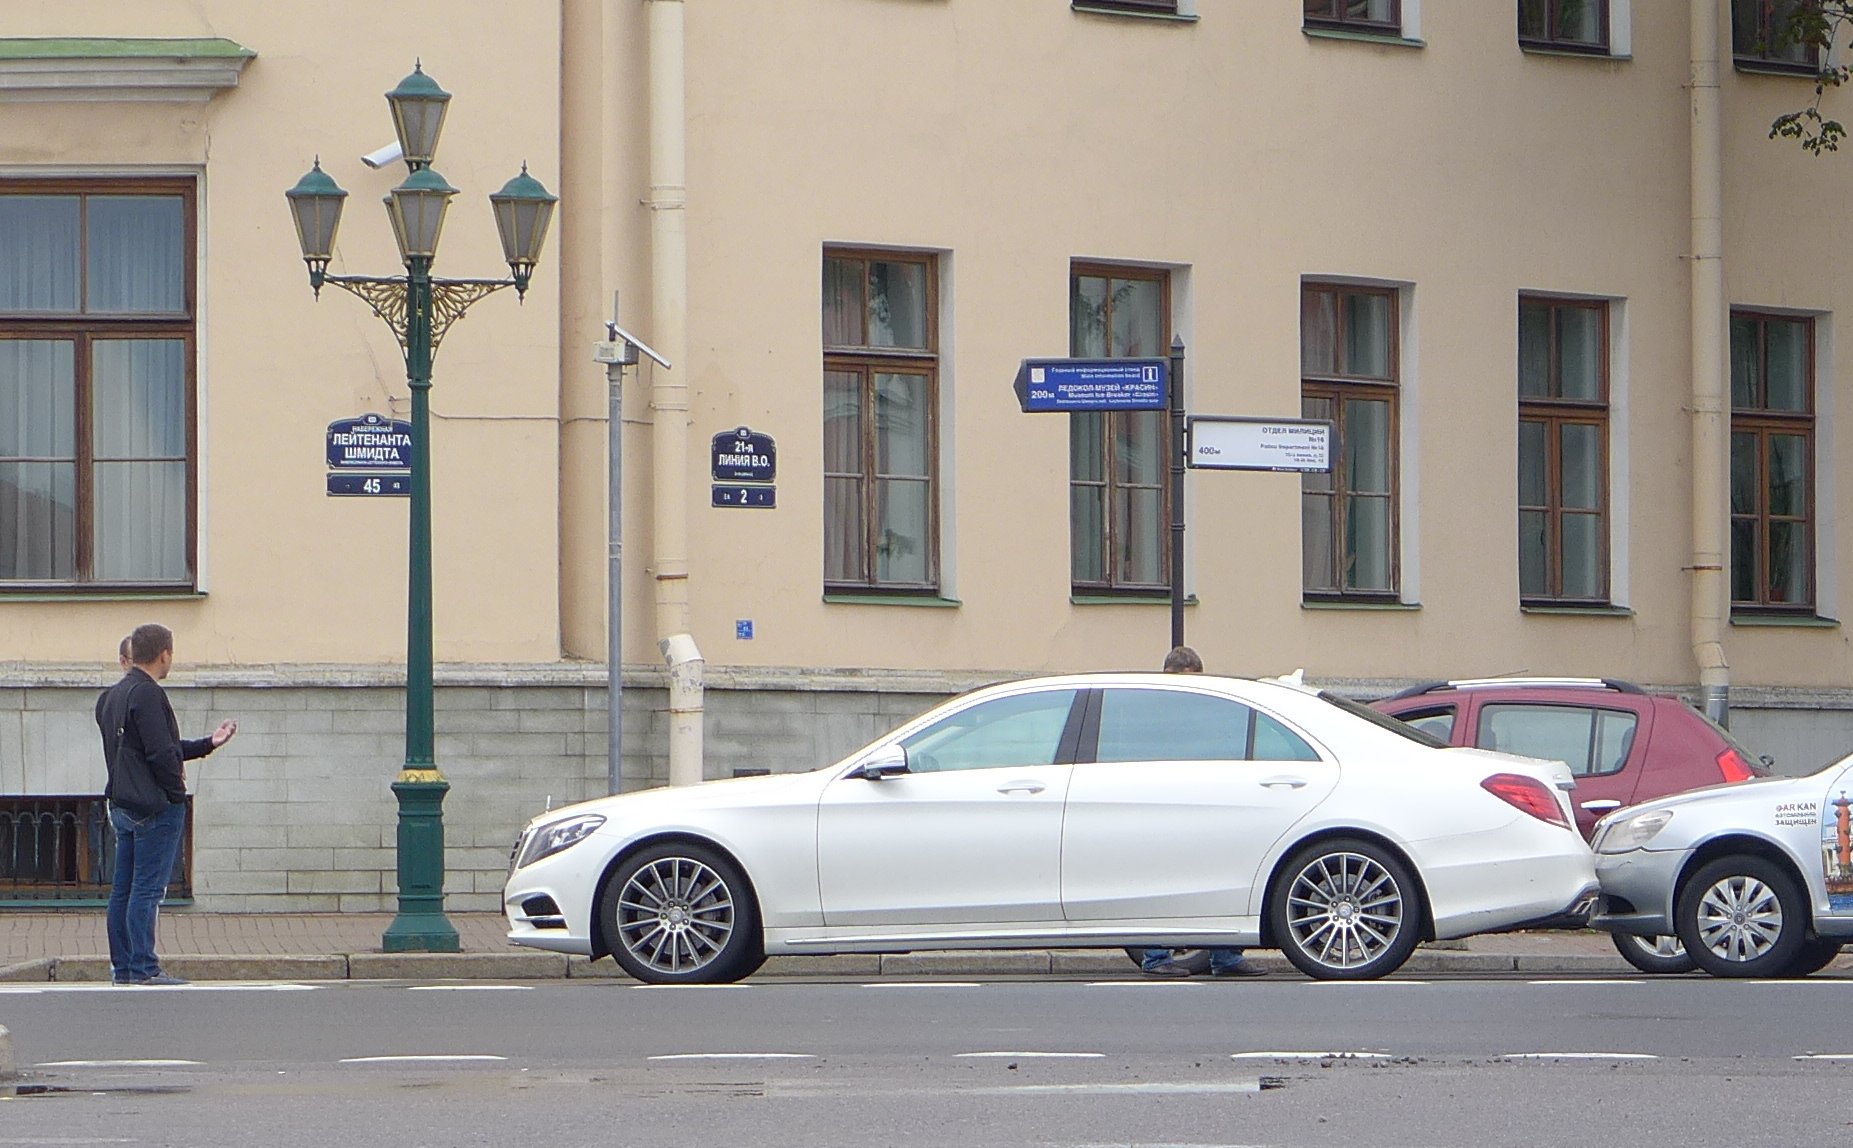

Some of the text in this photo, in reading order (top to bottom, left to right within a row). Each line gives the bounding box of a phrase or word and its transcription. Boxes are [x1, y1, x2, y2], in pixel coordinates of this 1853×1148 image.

[333, 432, 411, 445] ЛЕЙТЕНАНТА
[344, 446, 400, 460] ШМИДТА
[735, 441, 753, 453] 21-я
[718, 454, 770, 467] ЛИНИЯ В.О.
[363, 479, 381, 493] 45
[740, 489, 748, 504] 2
